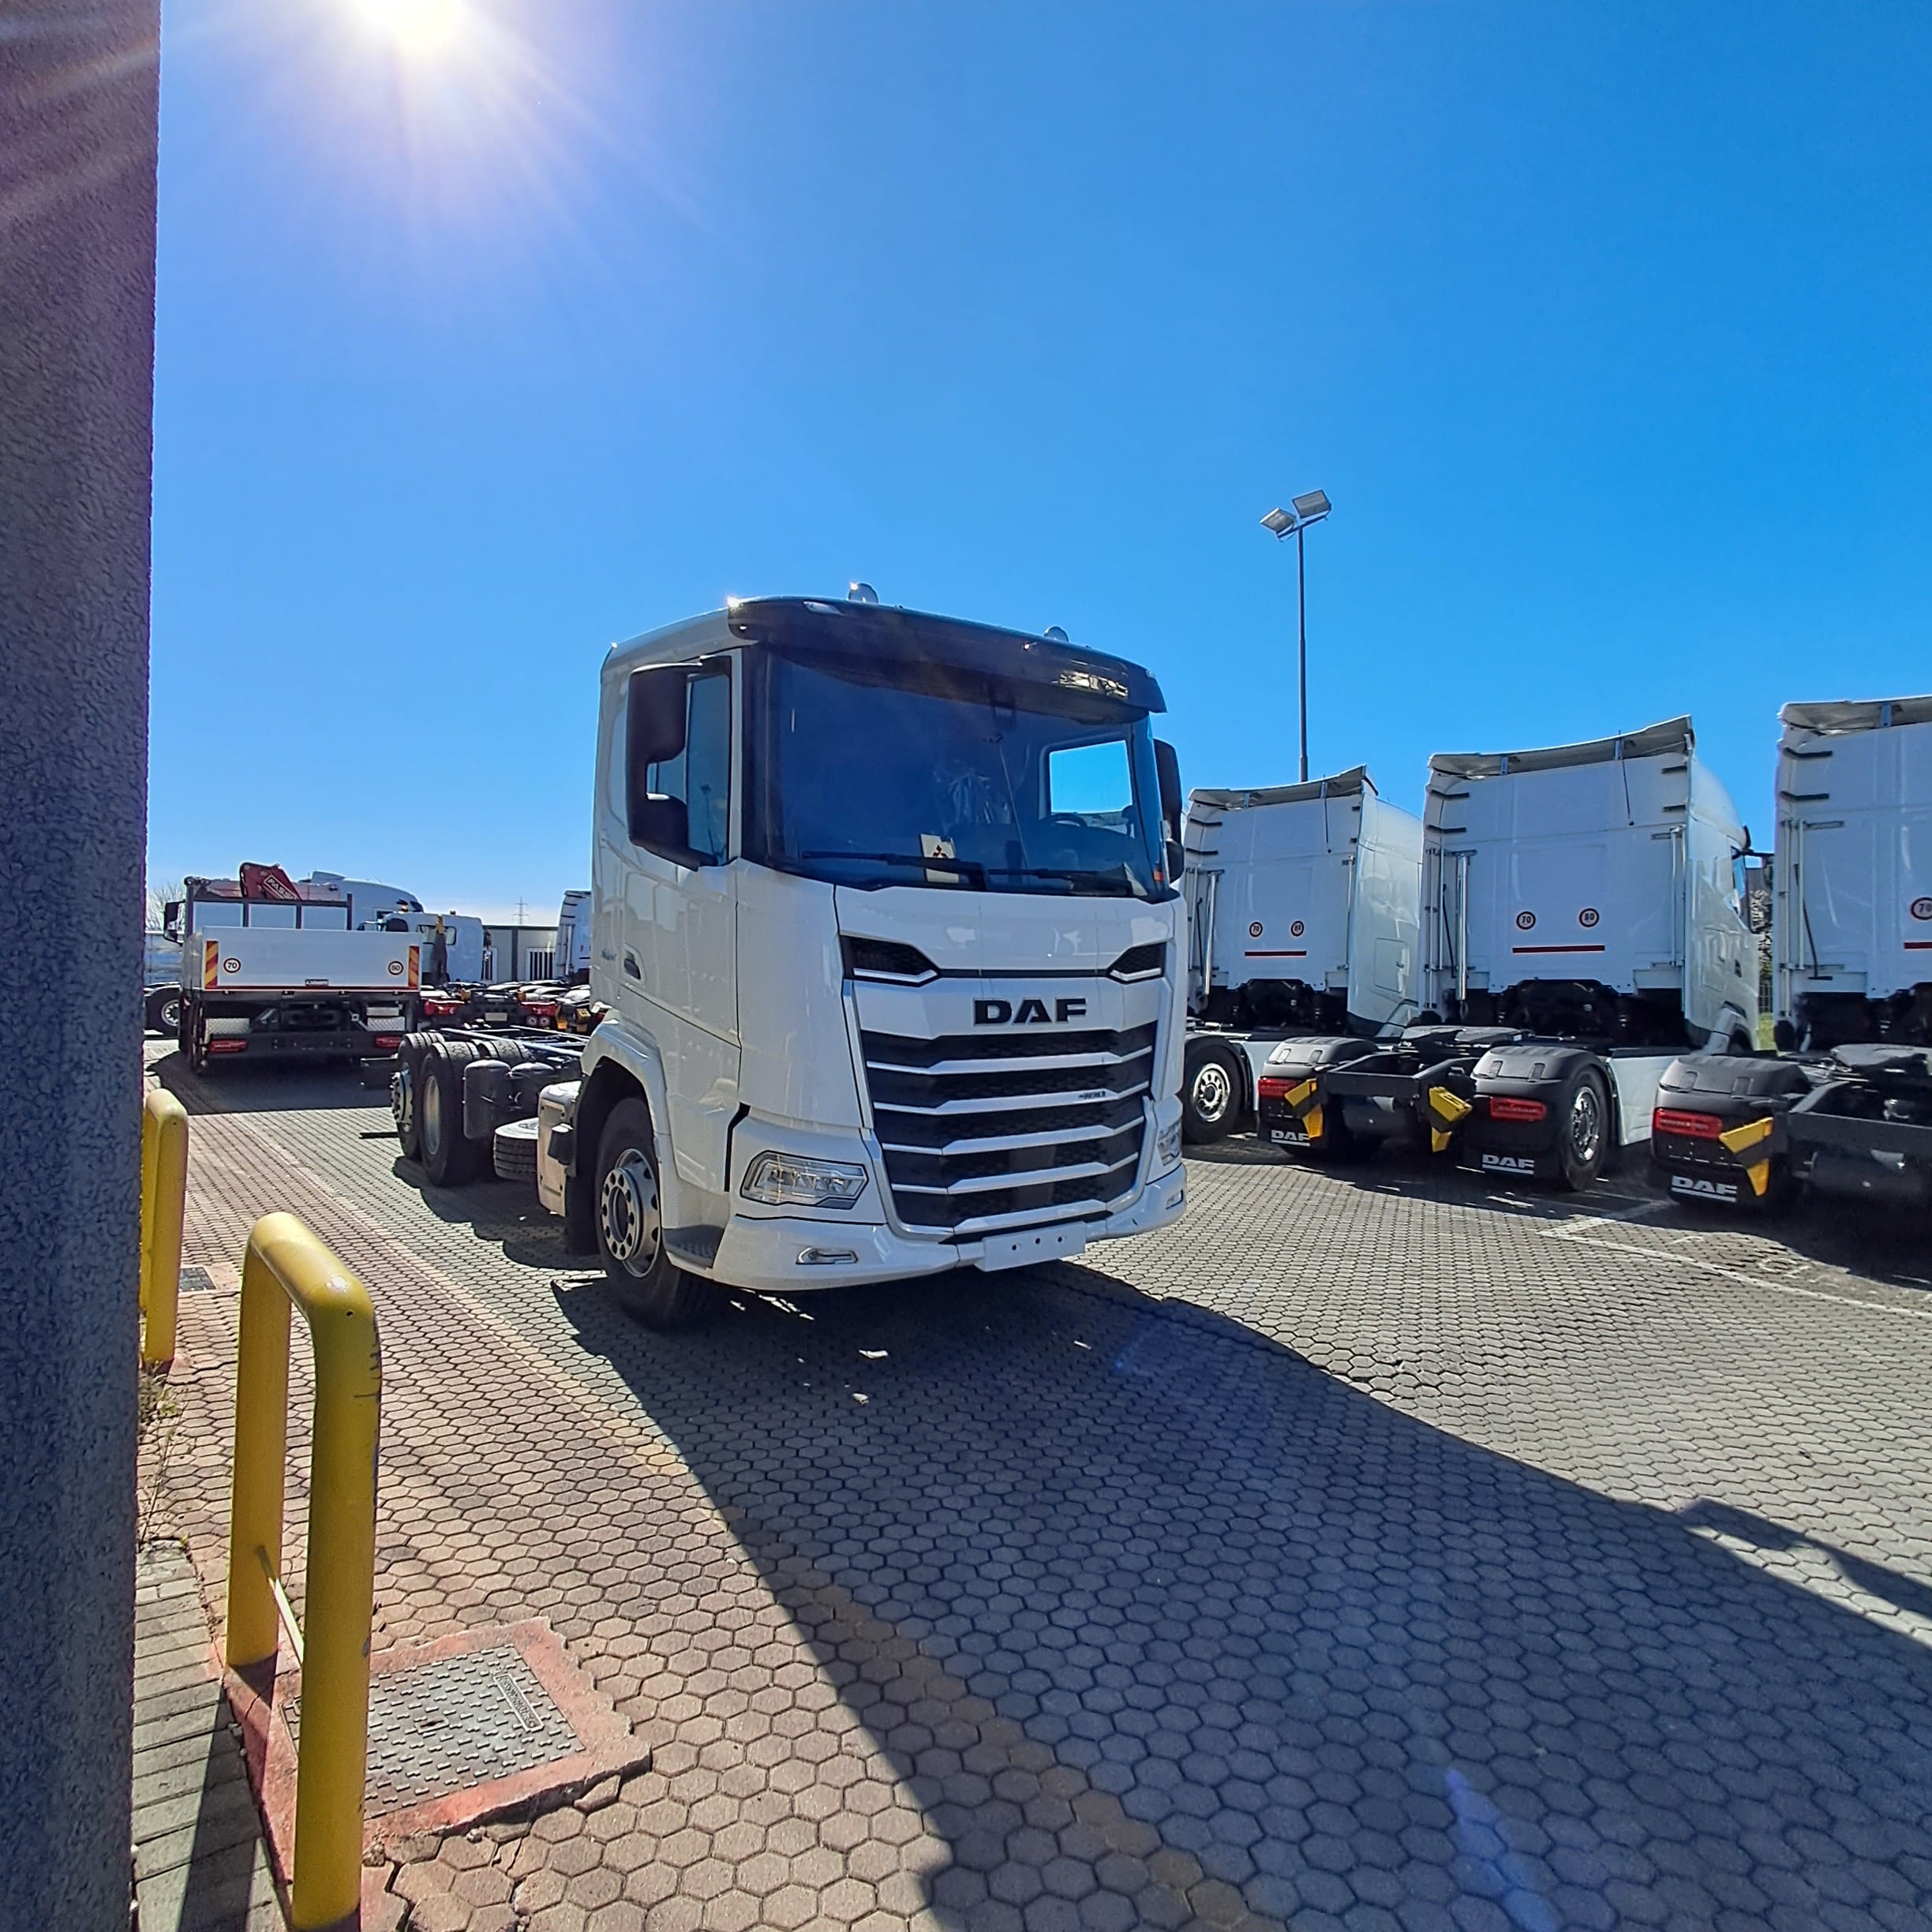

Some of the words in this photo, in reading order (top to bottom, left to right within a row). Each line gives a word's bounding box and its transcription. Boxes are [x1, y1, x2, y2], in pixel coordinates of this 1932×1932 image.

[972, 997, 1087, 1026] DAF
[1271, 1129, 1310, 1141] DAF
[1482, 1154, 1535, 1169] DAF
[1672, 1175, 1738, 1195] DAF
